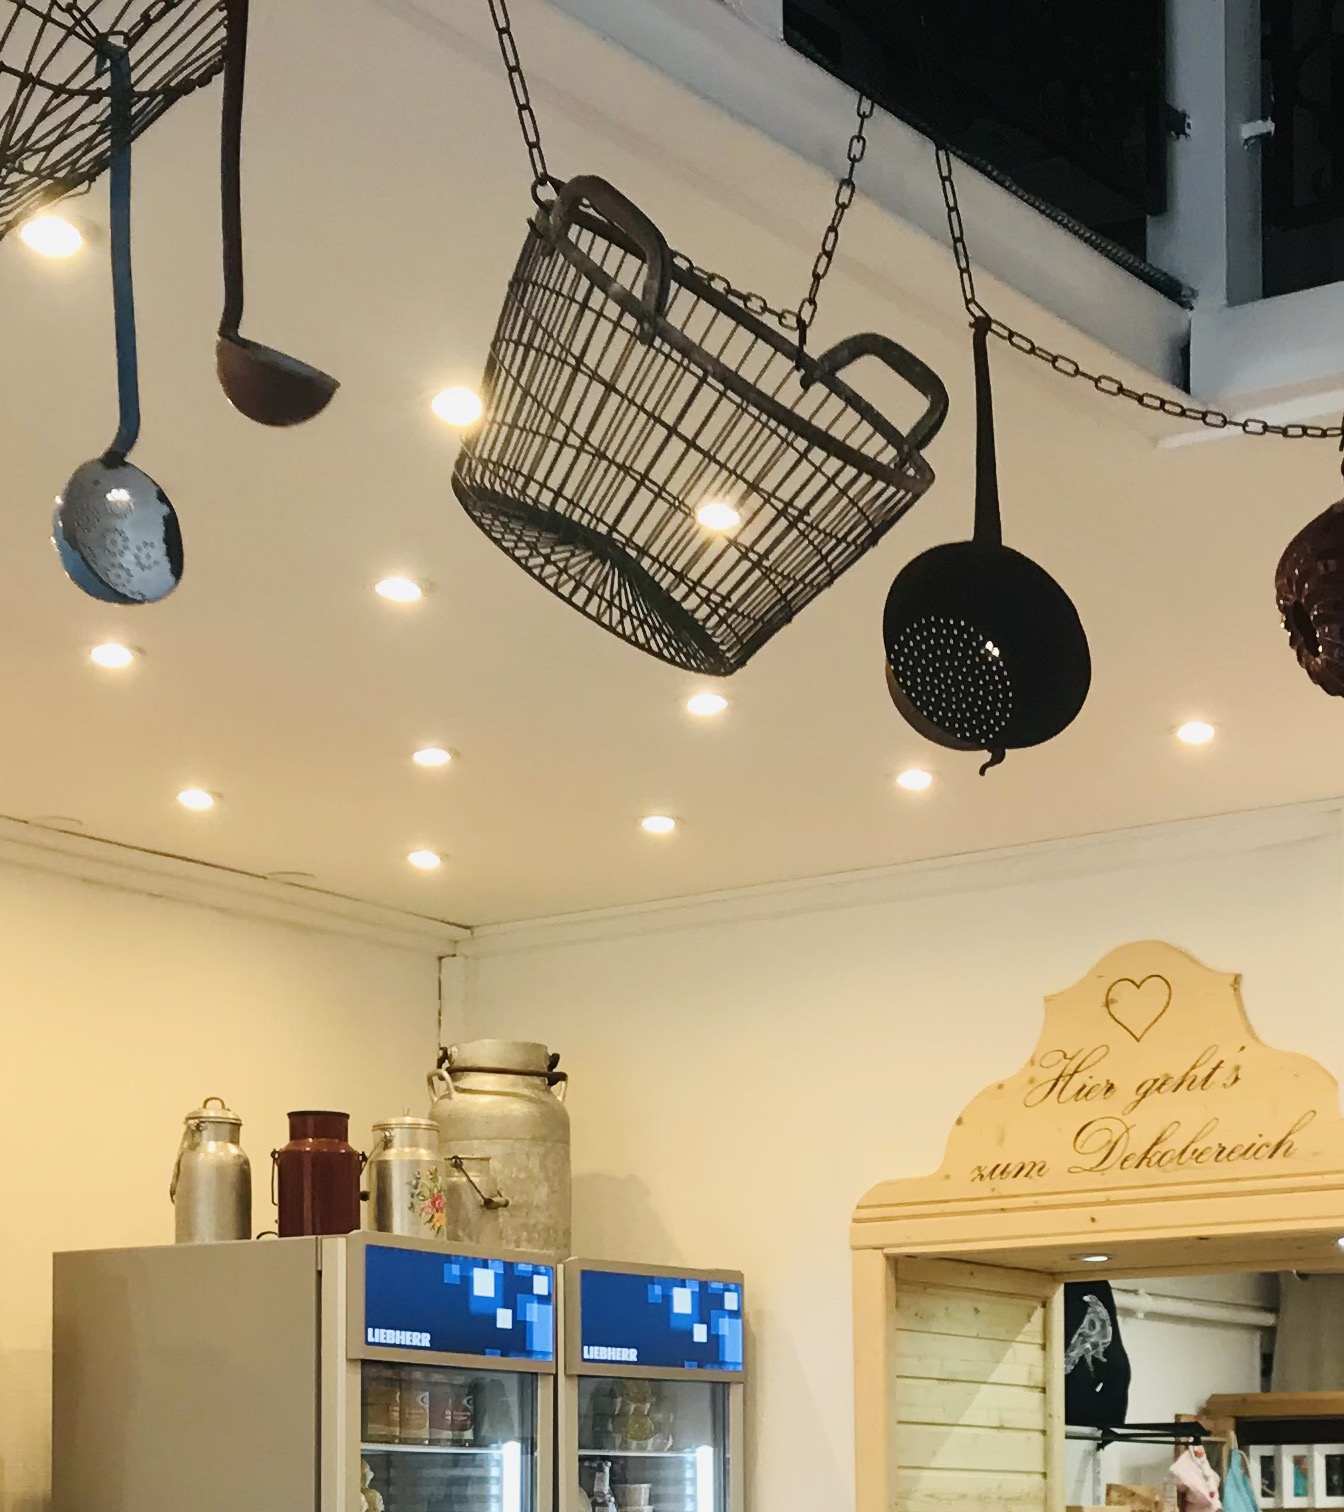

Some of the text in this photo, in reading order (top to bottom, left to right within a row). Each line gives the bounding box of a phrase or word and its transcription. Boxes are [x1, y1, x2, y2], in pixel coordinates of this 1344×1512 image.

[1023, 1045, 1246, 1114] Hier geht's
[970, 1110, 1317, 1184] zum Dekobereich
[367, 1327, 431, 1348] LIEBHERR
[583, 1345, 638, 1362] LIEBHERR
